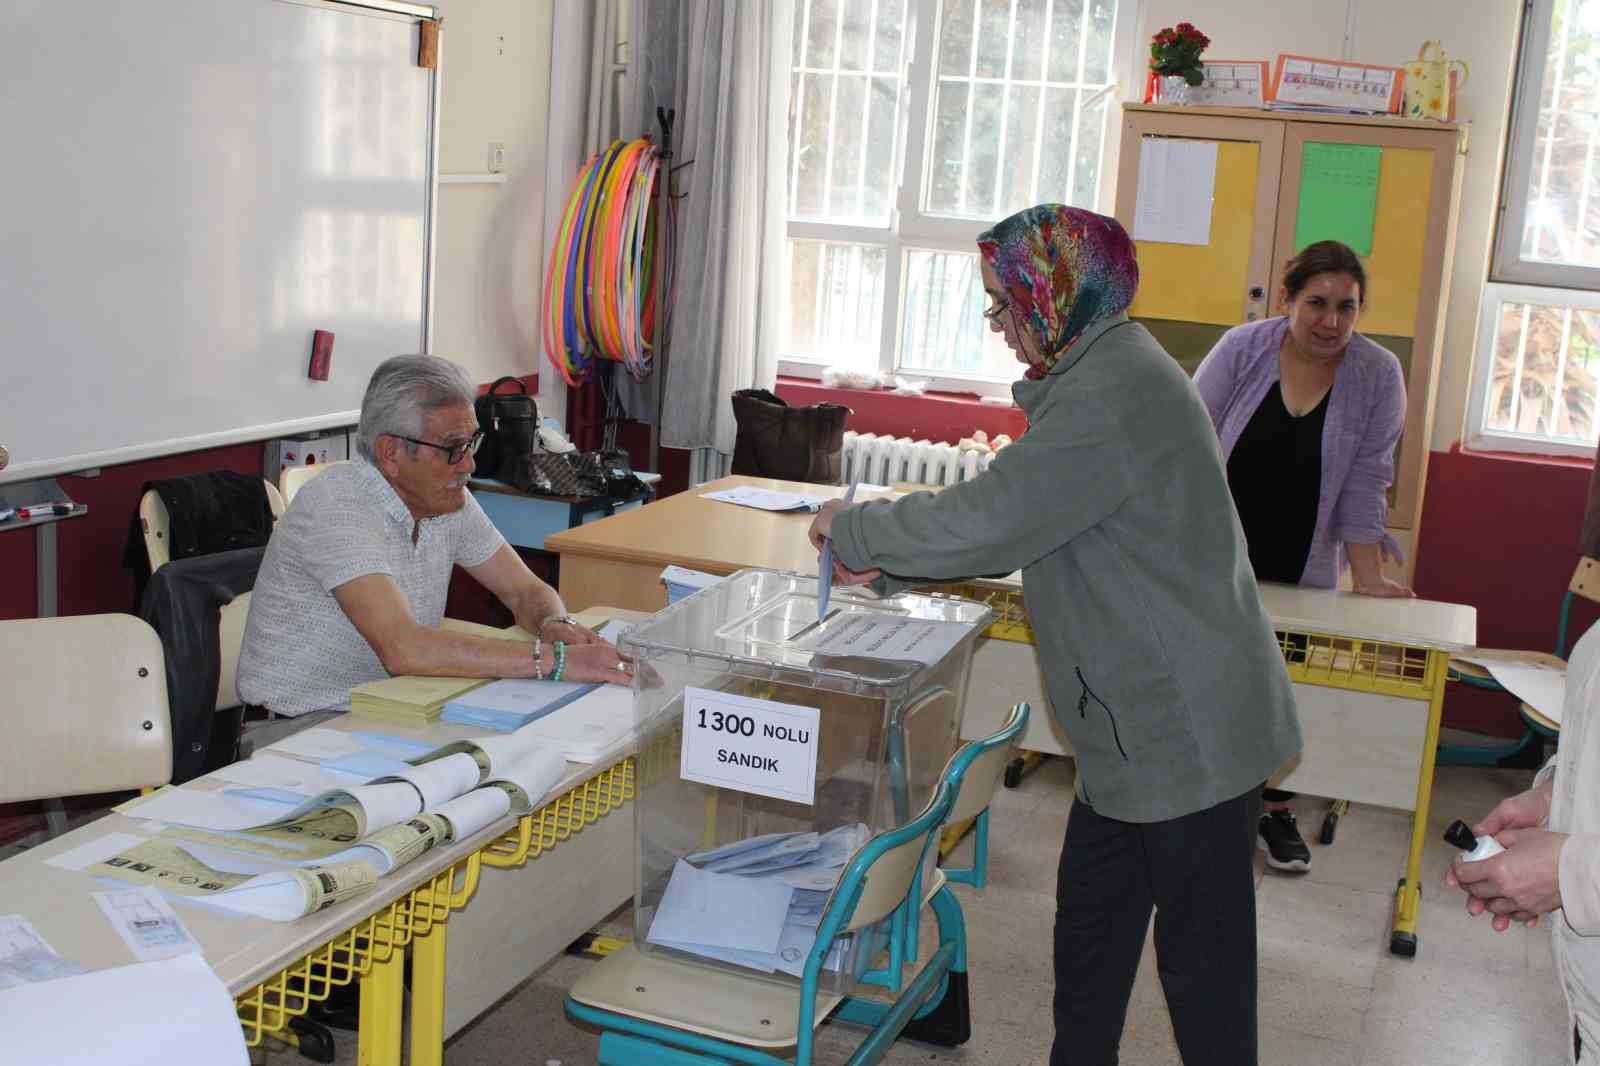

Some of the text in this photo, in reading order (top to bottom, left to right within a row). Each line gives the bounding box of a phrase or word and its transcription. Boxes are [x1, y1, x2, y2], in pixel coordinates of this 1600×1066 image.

[697, 708, 809, 744] 1300 NOLU
[717, 748, 779, 773] SANDIK
